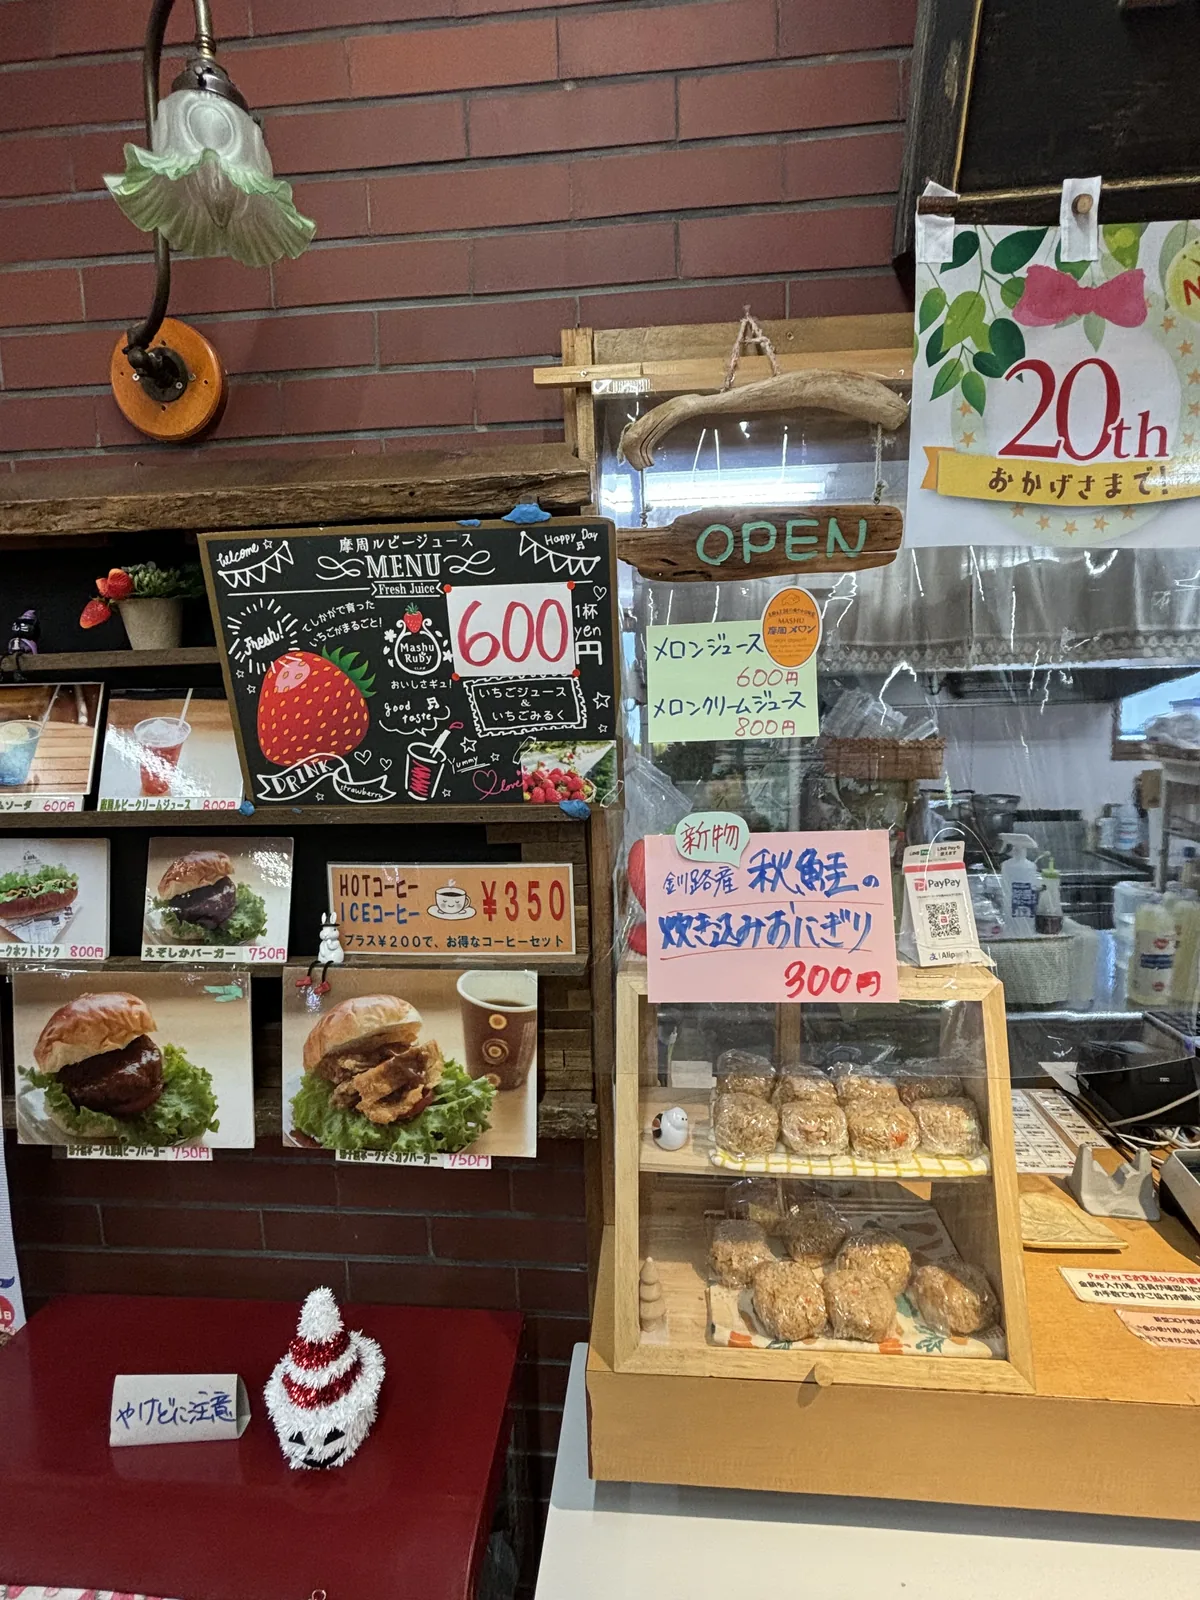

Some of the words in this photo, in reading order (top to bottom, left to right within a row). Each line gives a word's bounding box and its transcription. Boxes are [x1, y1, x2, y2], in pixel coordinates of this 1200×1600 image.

[998, 358, 1169, 461] 20th
[339, 533, 473, 553] 摩周ルビージュース
[544, 532, 576, 545] Happy
[581, 528, 598, 541] Day
[696, 517, 867, 566] OPEN
[364, 553, 441, 579] MENU
[378, 583, 407, 595] Fresh
[409, 582, 435, 595] Juice
[301, 600, 375, 632] てしかがで育った
[575, 603, 599, 620] 1杯
[243, 620, 285, 655] Fresh!
[309, 617, 383, 648] いちごがまるごと!
[457, 598, 568, 667] 600
[574, 625, 601, 641] yen
[400, 642, 435, 652] Mashu
[575, 641, 603, 665] 円
[653, 632, 764, 661] メロンジュース
[404, 652, 432, 664] Ruby
[736, 667, 799, 687] 600円
[479, 686, 567, 698] いちごジュース
[384, 700, 411, 717] good
[520, 699, 531, 707] &
[653, 690, 806, 718] メロンクリームジュース
[402, 712, 432, 724] taste
[492, 709, 565, 721] いちごみるく
[734, 717, 796, 737] 800円
[447, 756, 478, 774] Yummy
[270, 759, 334, 794] DRINK
[500, 779, 524, 792] love
[340, 784, 383, 800] strawberry
[42, 800, 75, 811] 600円
[203, 799, 236, 811] 800円
[680, 822, 740, 854] 新物
[339, 873, 419, 898] HOTコーヒー
[928, 876, 961, 890] PayPay
[481, 879, 565, 922] ¥350
[340, 902, 420, 925] ICEコーヒー
[658, 901, 872, 954] 炊き込みおにぎり
[69, 945, 104, 957] 800円
[144, 946, 236, 959] えぞしかバーガー
[249, 947, 286, 960] 750円
[784, 960, 882, 998] 300円
[172, 1147, 210, 1159] 750円
[449, 1154, 490, 1167] 750円
[116, 1391, 237, 1430] やけどに注意
